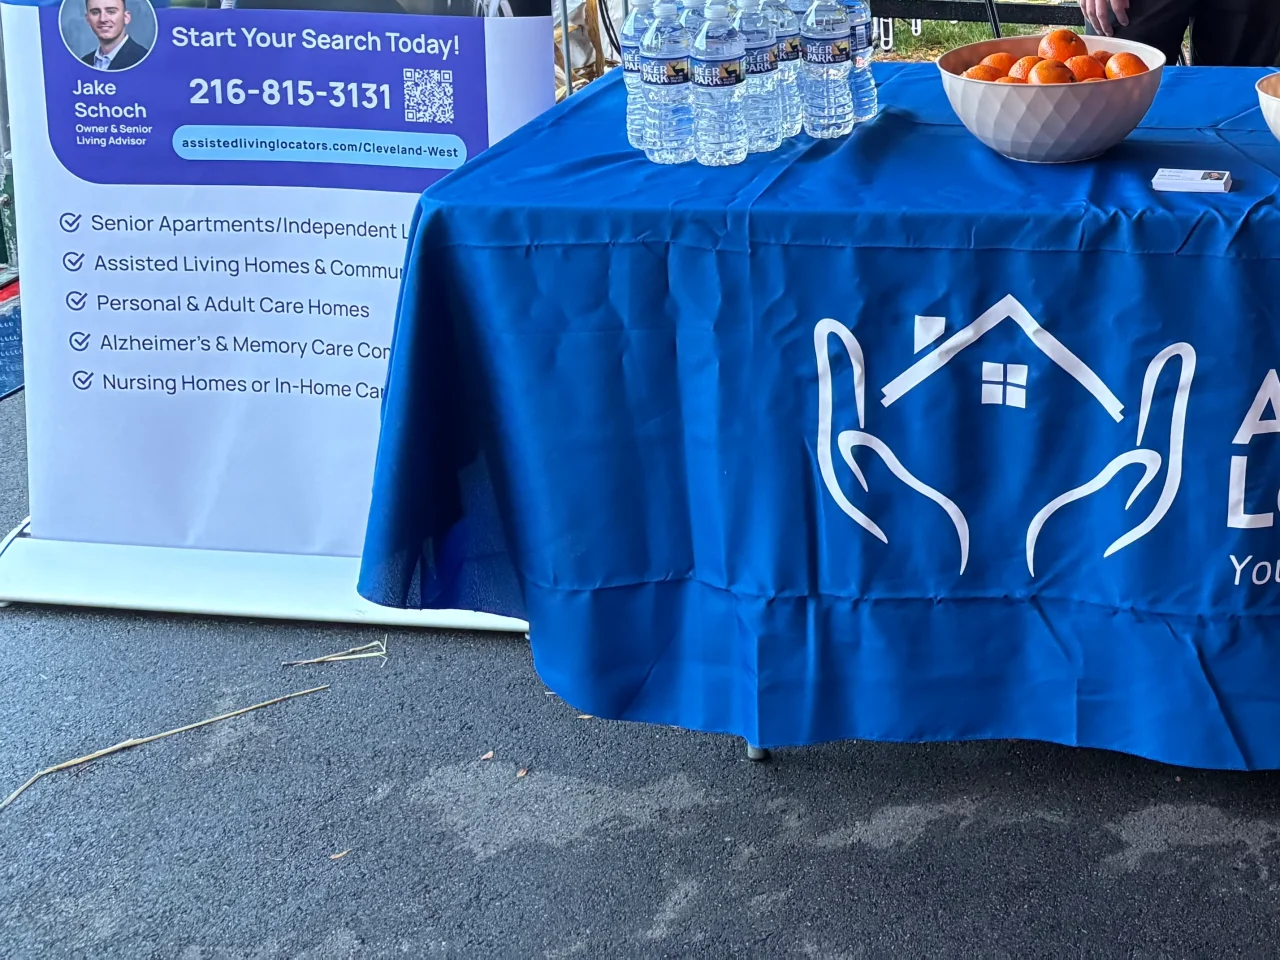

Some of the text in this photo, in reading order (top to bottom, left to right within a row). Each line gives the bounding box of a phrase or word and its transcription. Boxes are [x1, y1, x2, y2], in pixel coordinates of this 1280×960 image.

[172, 26, 460, 60] Start Your Search Today!
[807, 44, 832, 54] DEER
[624, 53, 639, 61] DEE
[807, 53, 833, 63] PARK
[643, 63, 667, 74] DEER
[695, 66, 720, 76] DEER
[643, 73, 668, 83] PARK
[695, 76, 721, 86] PARK
[73, 80, 116, 97] Jake
[189, 78, 391, 110] 216-815-3131
[74, 101, 147, 119] Schoch
[75, 123, 152, 135] Owner & Senior
[76, 136, 146, 147] Living Advisor
[182, 137, 459, 159] assistedlivinglocators.com/Cleveland-West
[91, 214, 154, 233] Senior
[158, 215, 397, 241] Apartments/Independent
[94, 255, 179, 273] Assisted
[182, 255, 240, 277] Living
[244, 257, 309, 275] Homes
[314, 259, 326, 276] &
[97, 295, 370, 318] Personal & Adult Care Homes
[216, 336, 228, 353] &
[233, 336, 308, 358] Memory
[311, 339, 354, 357] Care
[102, 374, 177, 396] Nursing
[181, 375, 247, 394] Homes
[251, 378, 270, 393] or
[275, 377, 351, 397] In-Home
